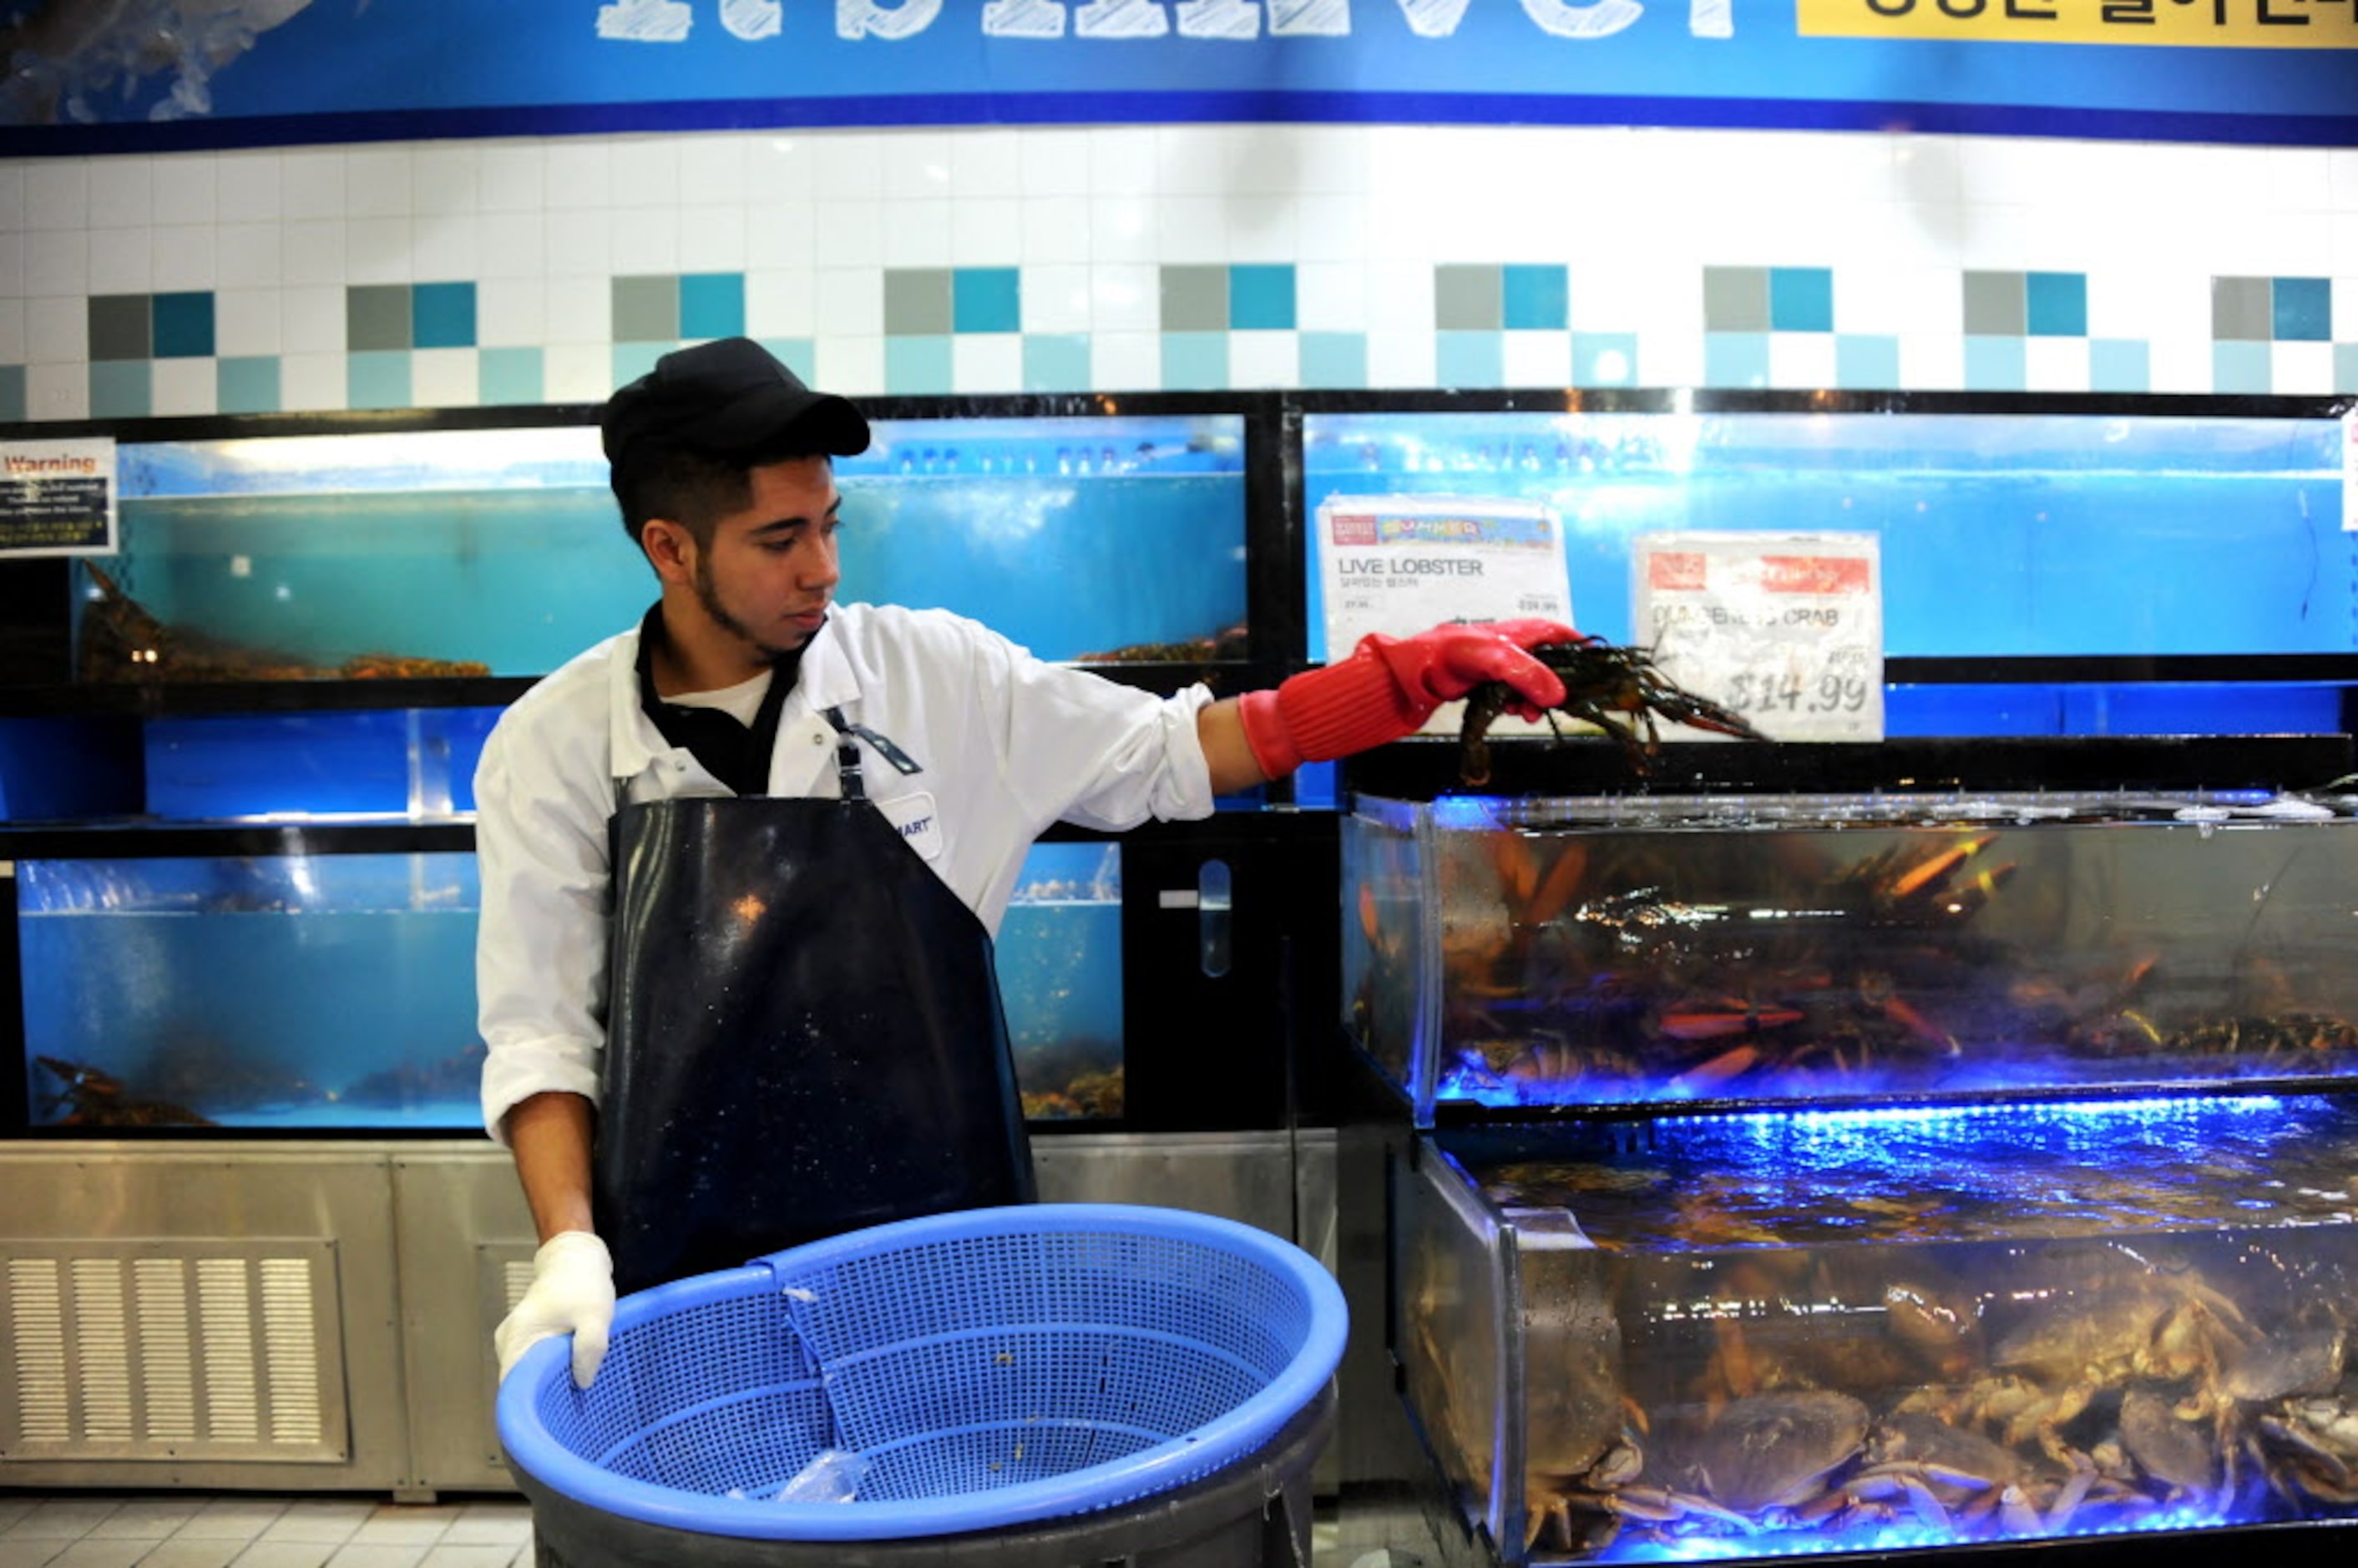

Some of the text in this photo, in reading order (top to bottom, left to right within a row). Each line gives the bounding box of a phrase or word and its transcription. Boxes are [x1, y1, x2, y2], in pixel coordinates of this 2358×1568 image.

[4, 454, 96, 474] Warning
[1338, 559, 1484, 576] LIVE LOBSTER
[1784, 609, 1839, 627] CRAB
[1728, 673, 1868, 713] $14.99
